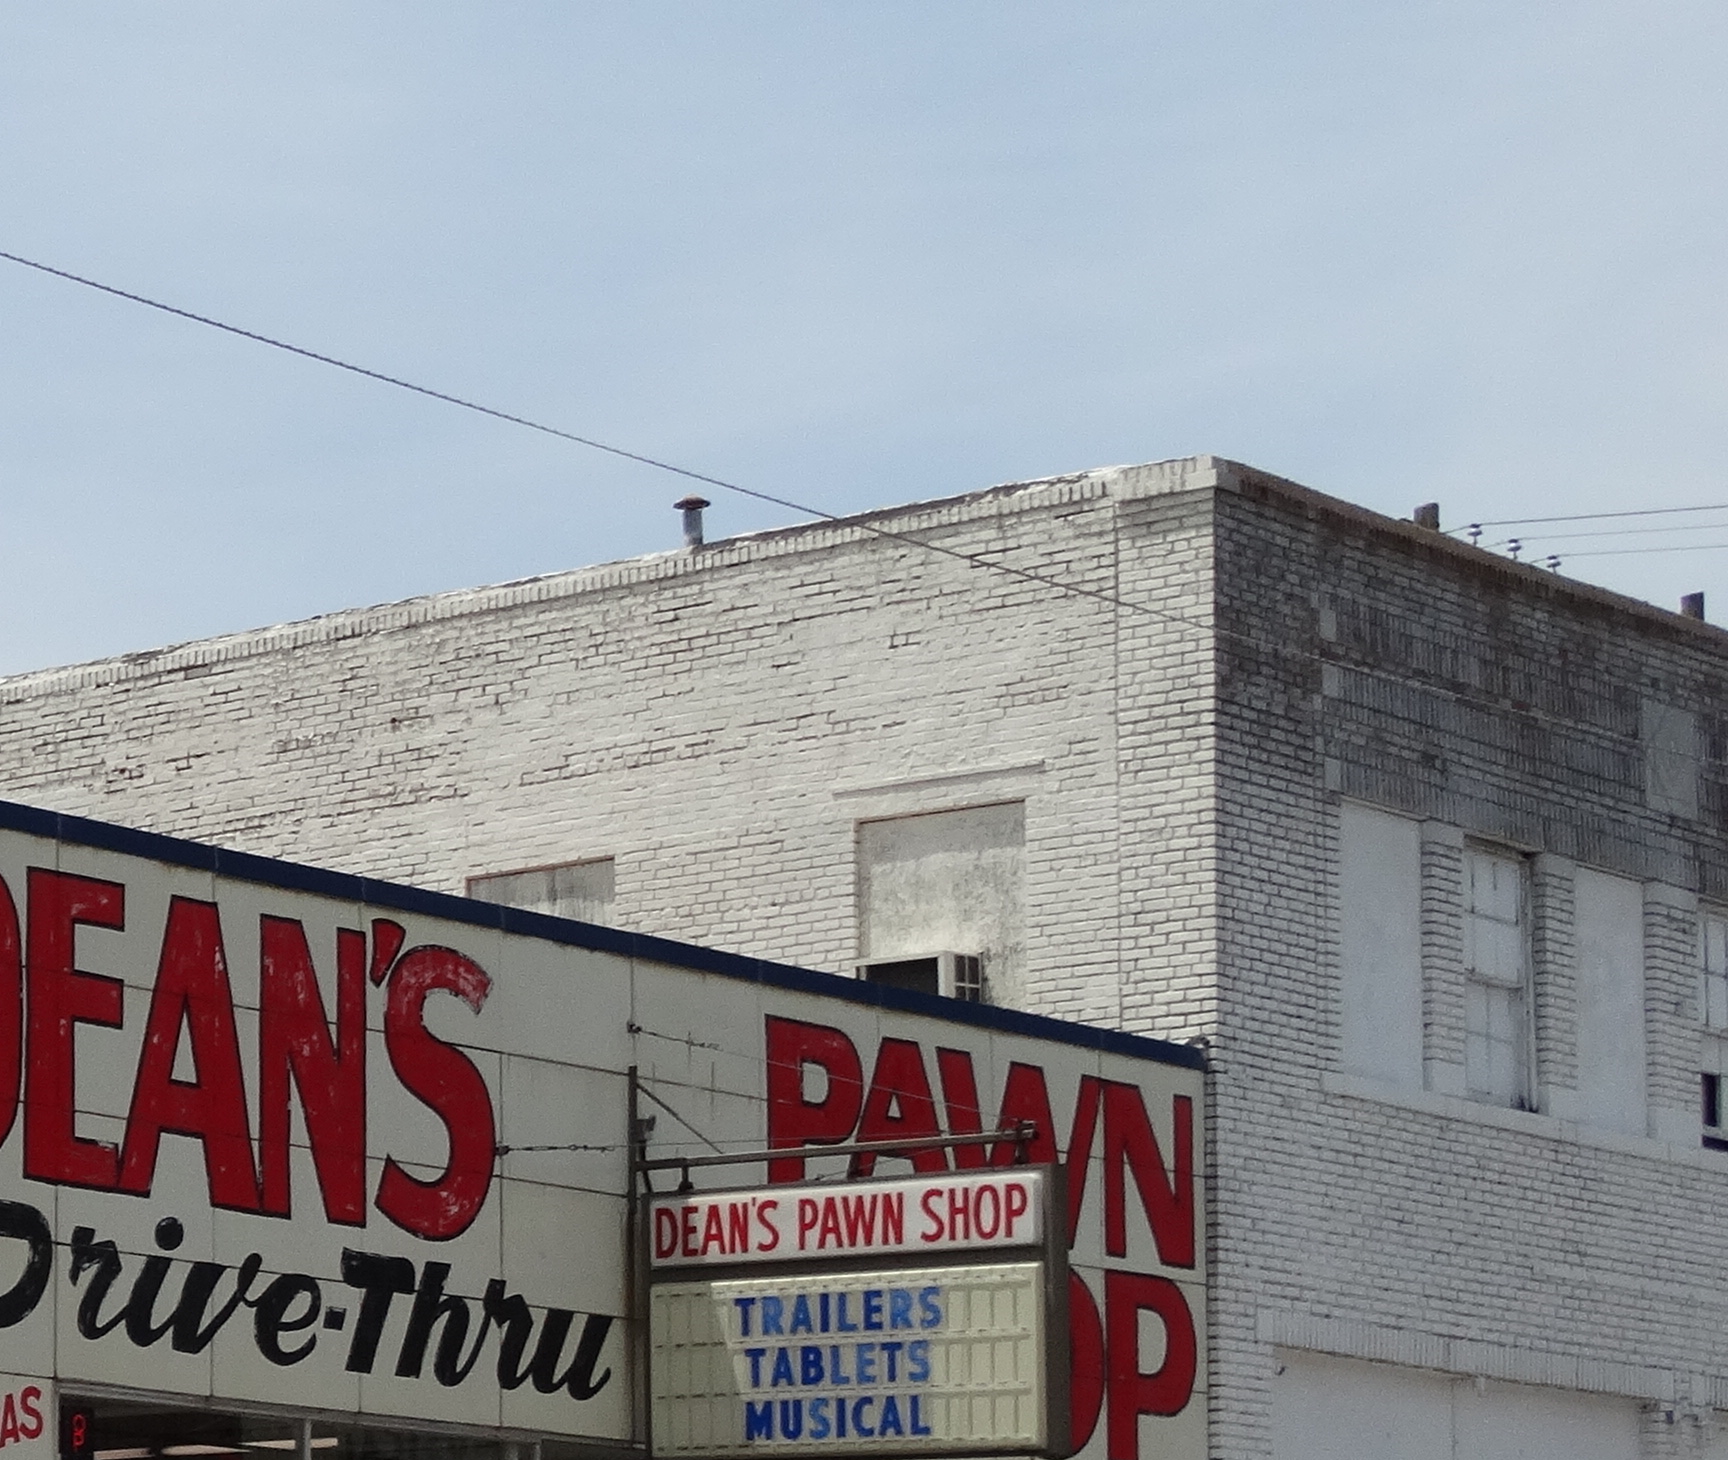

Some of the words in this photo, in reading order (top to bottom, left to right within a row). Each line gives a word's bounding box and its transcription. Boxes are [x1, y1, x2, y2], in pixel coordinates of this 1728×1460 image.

[765, 1014, 1196, 1270] PAWN
[654, 1198, 779, 1259] DEAN'S
[798, 1192, 904, 1250] PAWN
[920, 1183, 1028, 1243] SHOP
[734, 1286, 943, 1337] TRAILERS
[744, 1340, 931, 1388] TABLETS
[745, 1394, 932, 1441] MUSICAL
